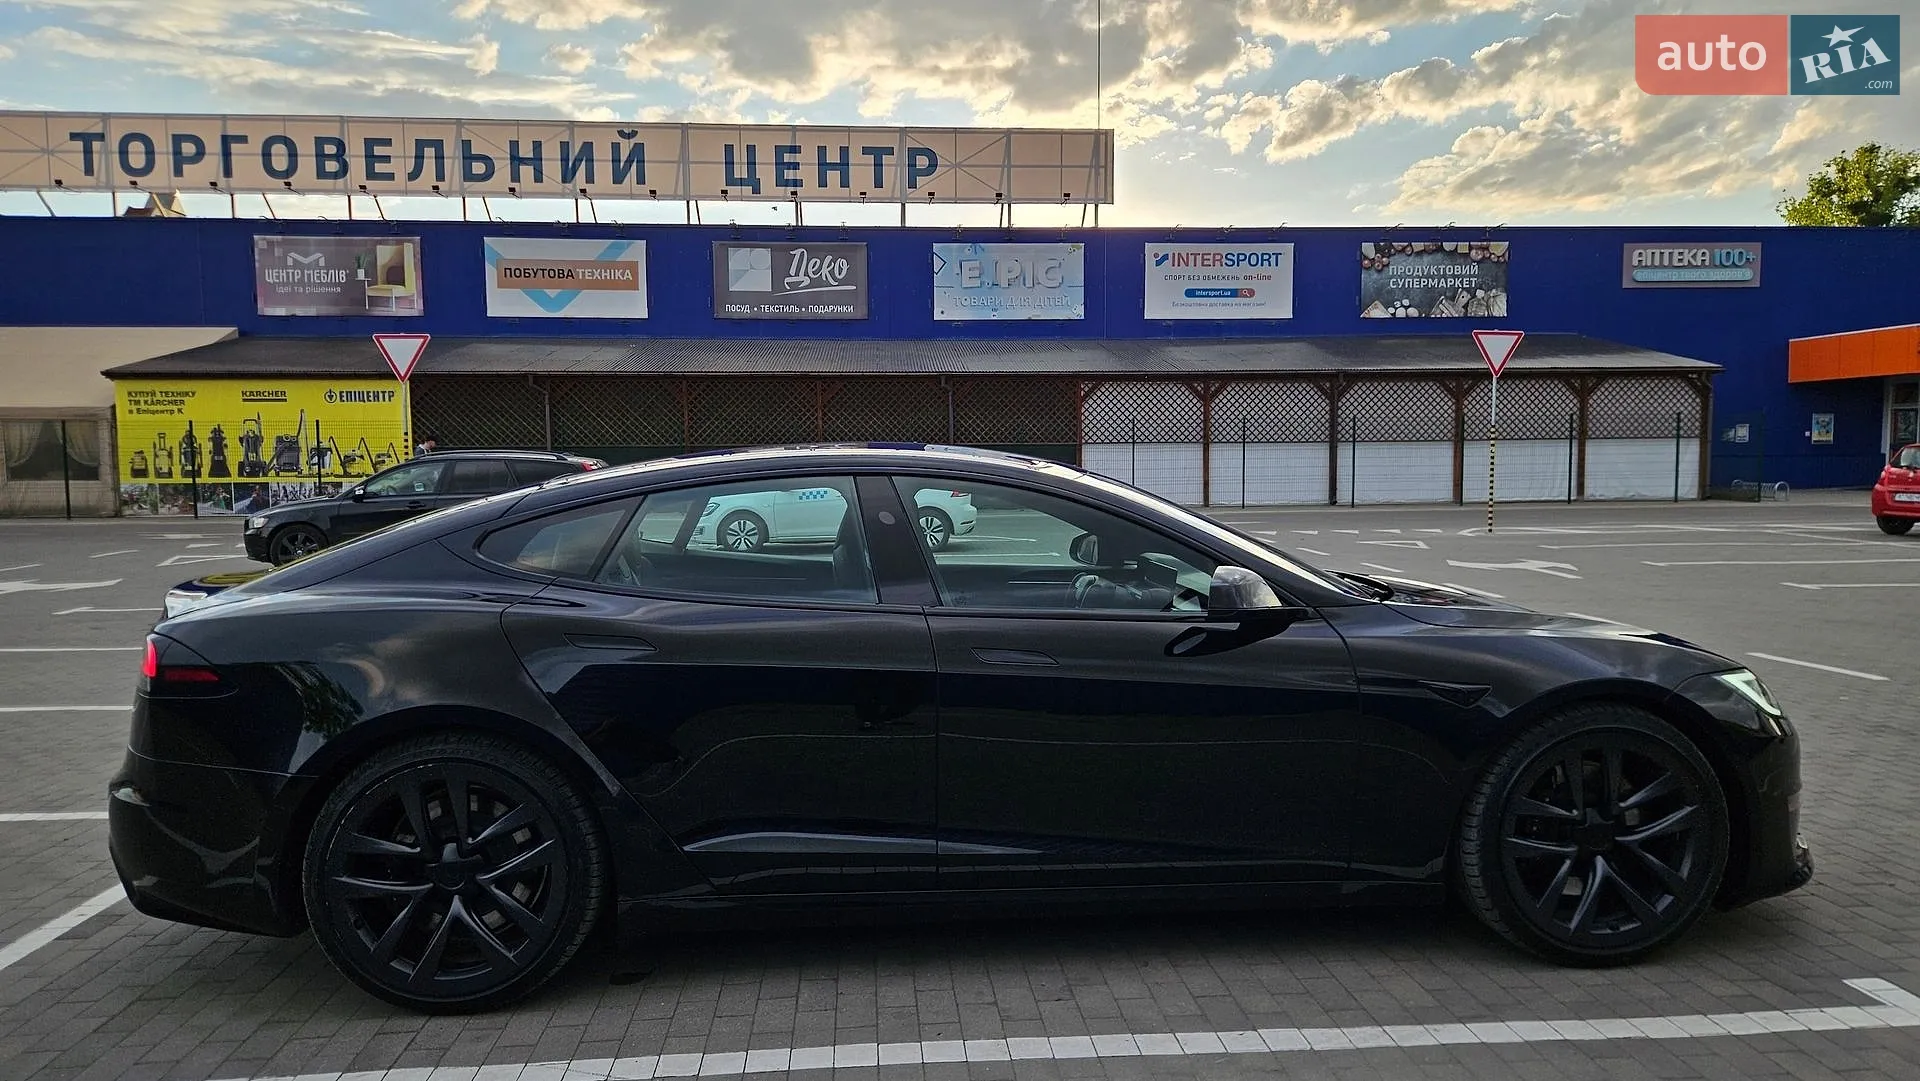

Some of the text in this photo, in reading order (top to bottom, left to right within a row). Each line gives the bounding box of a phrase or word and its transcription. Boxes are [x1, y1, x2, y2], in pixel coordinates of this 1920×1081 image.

[69, 129, 939, 195] ТОРГОВЕЛЬНИЙ ЦЕНТР
[1171, 252, 1282, 267] INTERSPORT
[1632, 248, 1757, 267] АПТЕКА 100+
[504, 267, 633, 281] ПОБУТОВА ТЕХНІКА
[784, 248, 850, 290] Деко
[1389, 263, 1479, 276] ПРОДУКТОВИЙ
[265, 269, 301, 283] ЦЕНТР
[1243, 273, 1272, 281] on-line
[306, 285, 341, 294] рішення
[1389, 278, 1478, 288] СУПЕРМАРКЕТ
[1195, 289, 1231, 297] intersport.ua
[953, 295, 1071, 309] ТОВАРИ ДЛЯ ДІТЕЙ
[725, 304, 854, 314] ПОСУД ТЕКСТИЛЬ ПОДАРУНКИ
[127, 390, 156, 398] КУПУЙ
[339, 390, 395, 403] ЕПІЦЕНТР
